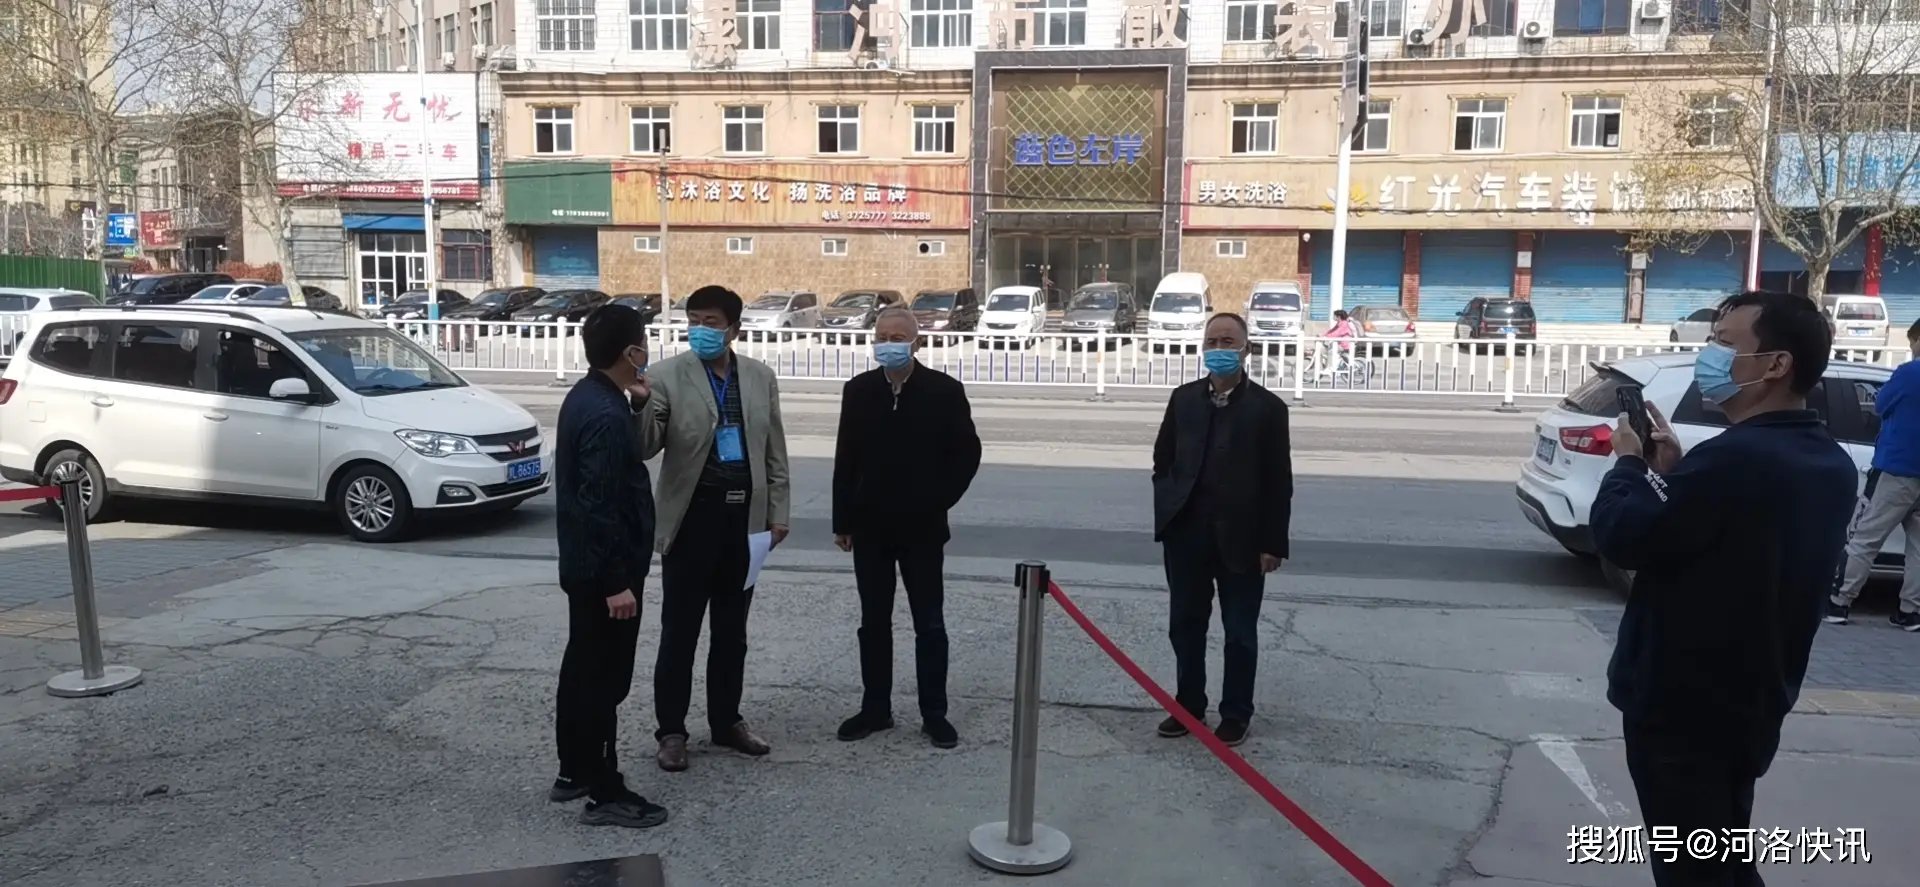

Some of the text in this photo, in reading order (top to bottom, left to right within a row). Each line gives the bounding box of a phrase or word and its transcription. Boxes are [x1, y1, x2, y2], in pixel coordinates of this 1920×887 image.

[1014, 133, 1144, 167] 蓝色左岸
[789, 182, 909, 204] 扬洗浴品牌
[1199, 180, 1288, 203] 男女洗浴
[847, 210, 887, 220] 3725777
